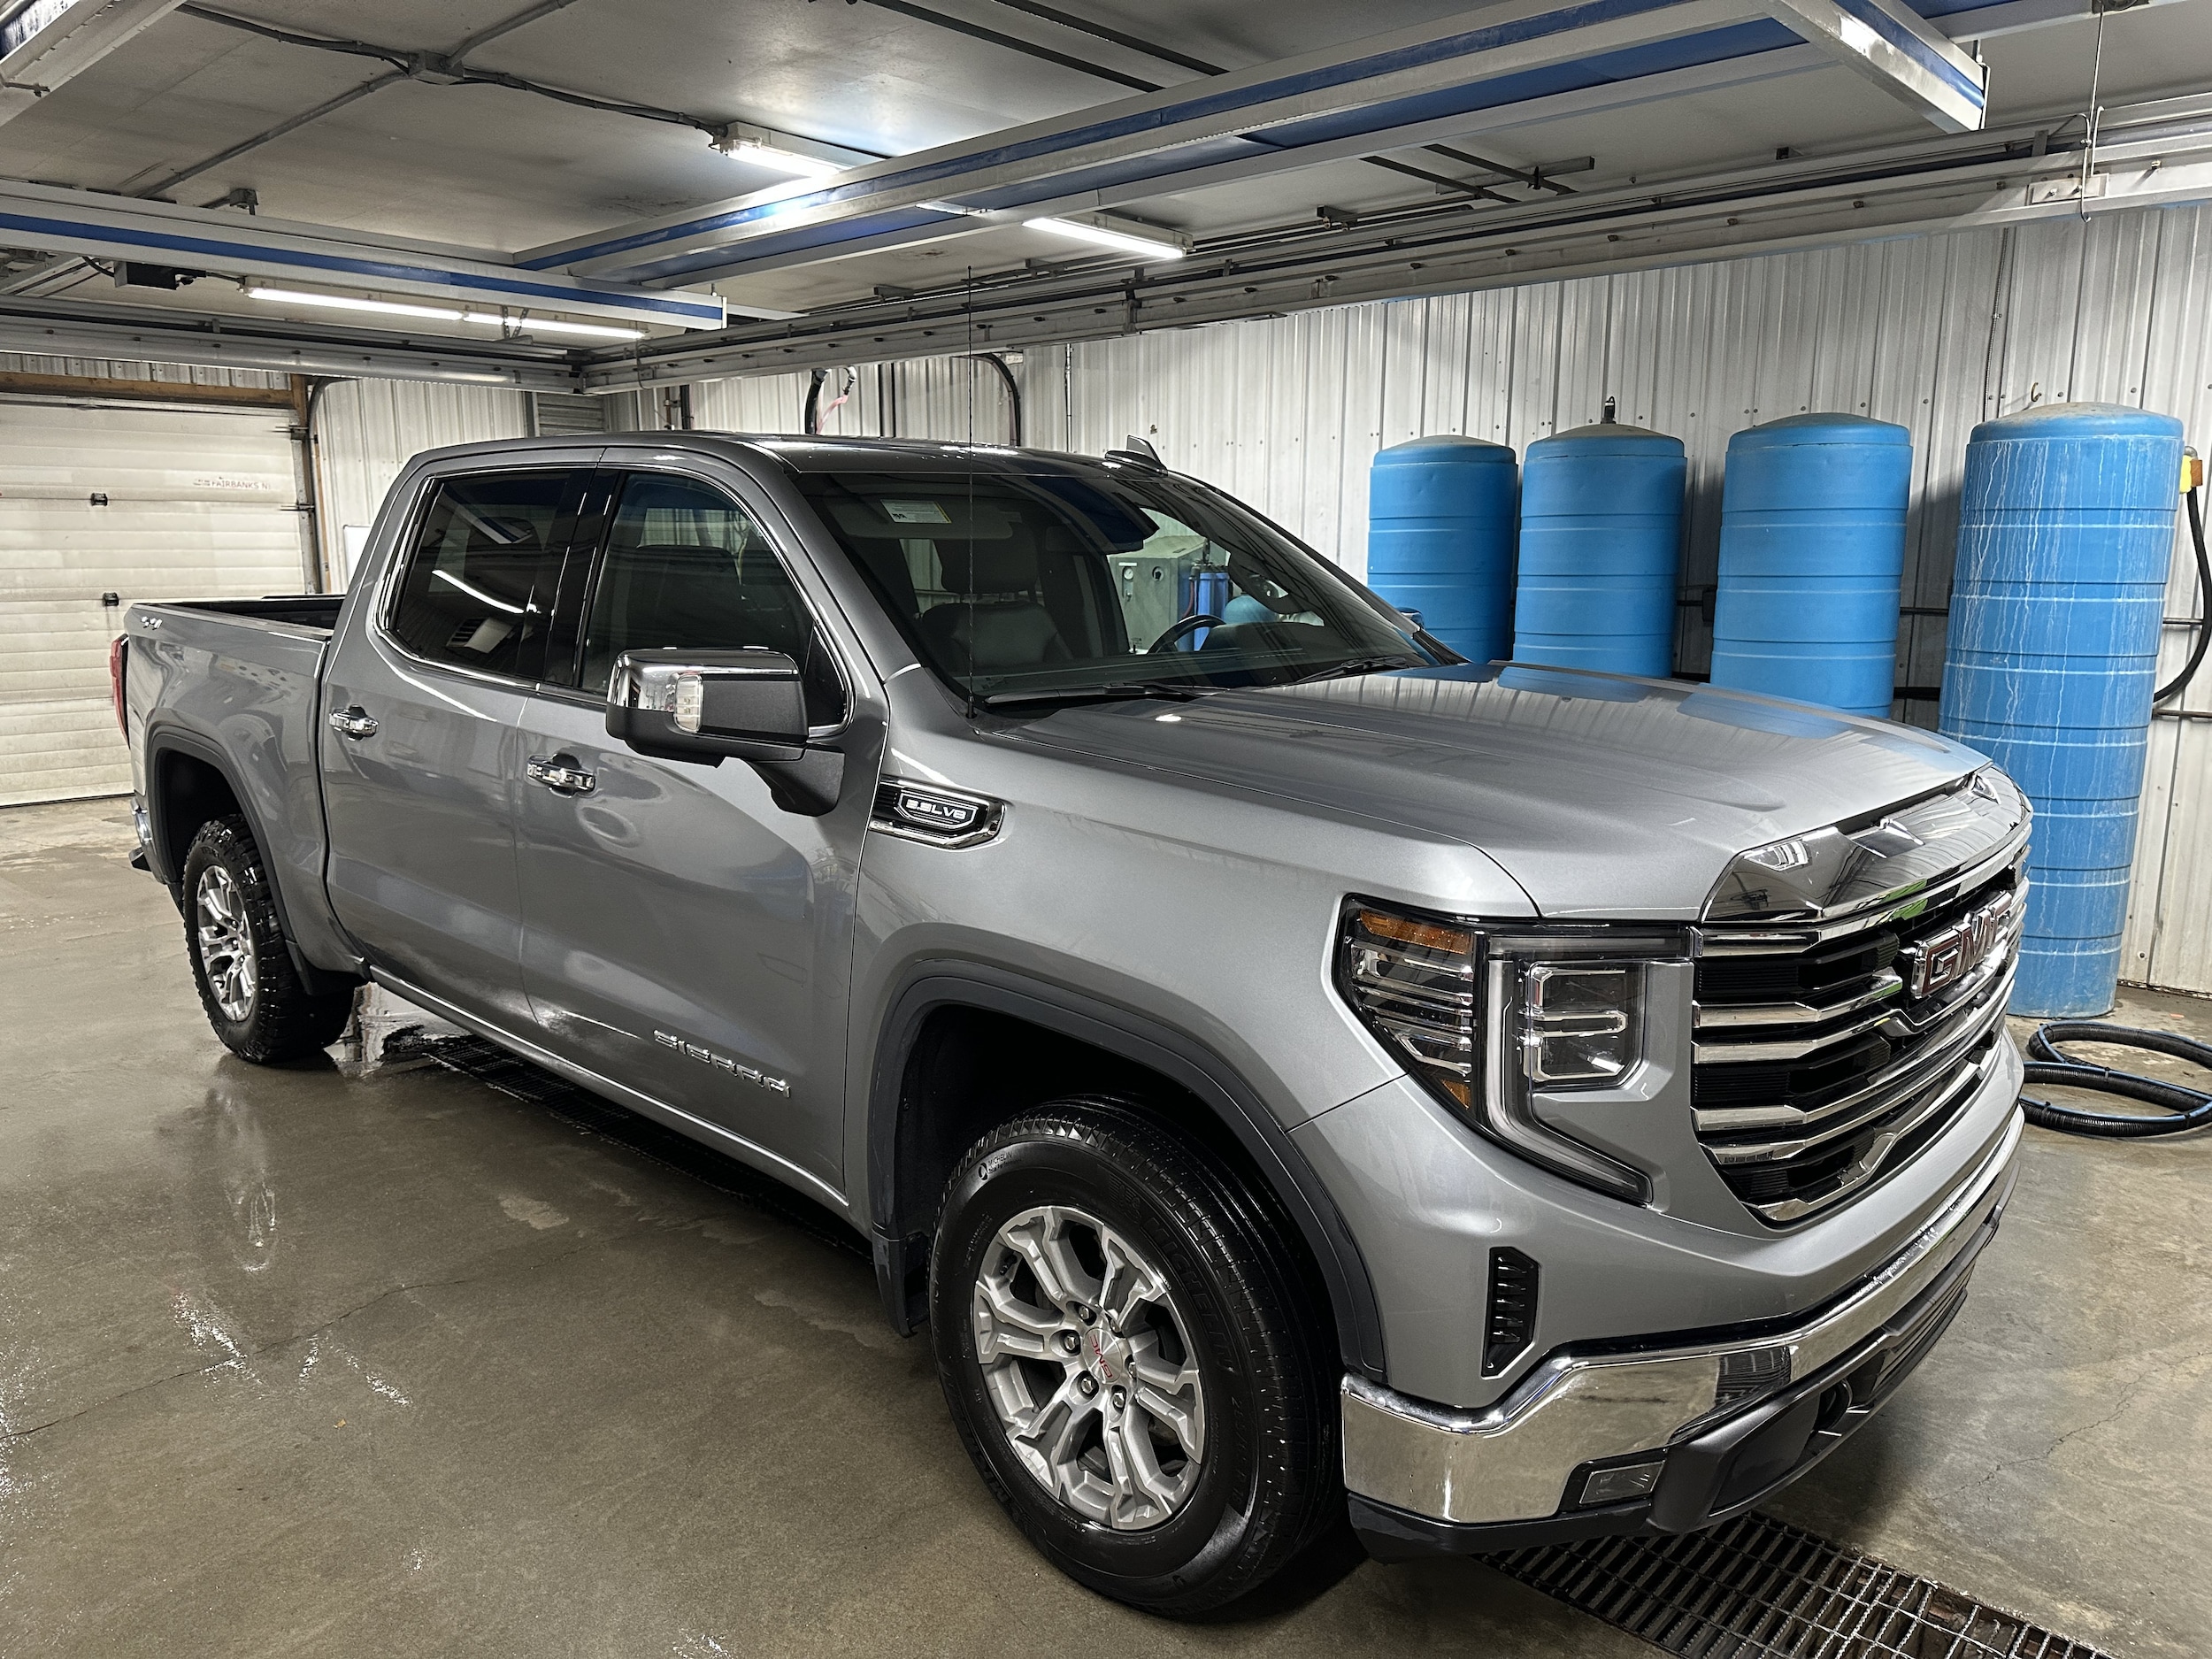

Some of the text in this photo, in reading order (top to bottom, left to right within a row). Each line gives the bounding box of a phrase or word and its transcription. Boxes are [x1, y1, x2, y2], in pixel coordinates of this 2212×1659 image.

[211, 480, 259, 489] FAIRBANKS
[1912, 891, 2013, 1000] GMC
[653, 1029, 790, 1098] SIERRA
[1089, 1334, 1113, 1378] GMC
